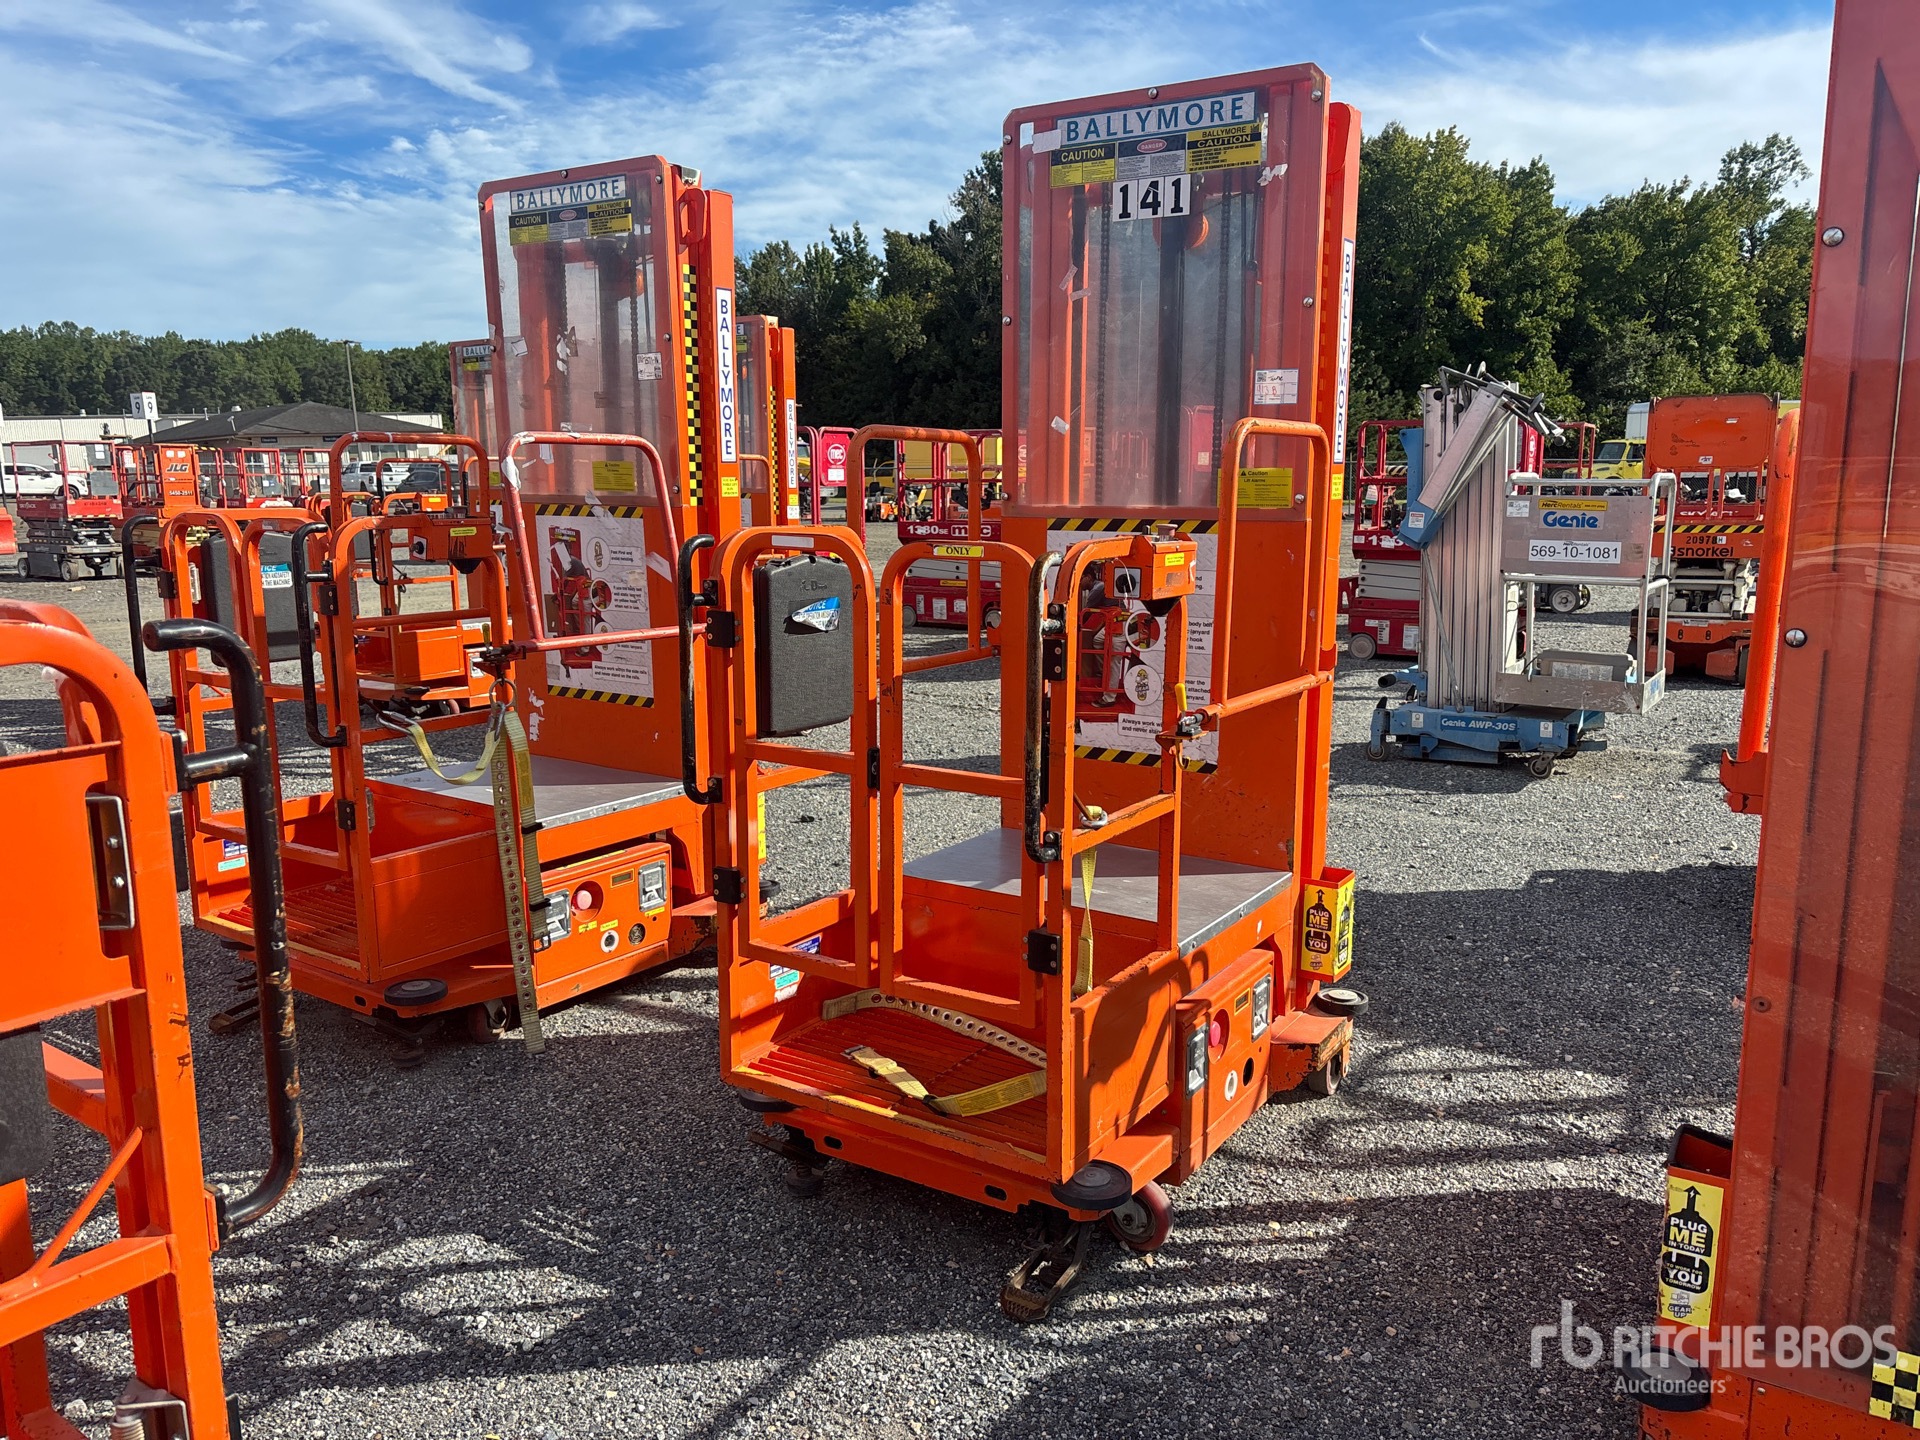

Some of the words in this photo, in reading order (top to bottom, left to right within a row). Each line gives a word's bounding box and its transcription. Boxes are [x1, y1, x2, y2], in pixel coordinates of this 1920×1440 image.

[1066, 96, 1244, 142] BALLYMORE
[1202, 126, 1247, 138] BALLYMORE
[1141, 142, 1164, 150] DANGER
[1197, 134, 1251, 148] CAUTION
[1061, 147, 1105, 162] CAUTION
[516, 179, 619, 210] BALLYMORE
[1118, 177, 1184, 219] 141
[594, 208, 625, 218] CAUTION
[515, 215, 541, 226] CAUTION
[1336, 253, 1350, 454] BALLYMORE
[720, 299, 733, 454] BALLYMORE
[135, 402, 140, 414] 9
[148, 402, 153, 414] 9
[788, 404, 796, 485] BALLYMORE
[167, 464, 189, 473] JLG
[1543, 511, 1599, 528] Genie
[951, 525, 992, 537] mc
[946, 547, 971, 556] ONLY
[1531, 545, 1618, 559] 569-10-1081
[1677, 546, 1734, 557] snorkel
[1122, 718, 1141, 726] Always
[1441, 718, 1466, 727] Genie
[1468, 720, 1516, 731] AWP-30S
[1309, 908, 1329, 918] PLUG
[1309, 915, 1329, 927] ME
[1308, 939, 1328, 950] YOU
[1670, 1216, 1708, 1234] PLUG
[1669, 1226, 1707, 1249] ME
[1668, 1240, 1677, 1248] IN
[1679, 1243, 1706, 1255] TODAY
[1675, 1265, 1690, 1273] WORK
[1668, 1268, 1703, 1286] YOU
[1665, 1277, 1702, 1291] TOMORROW
[1668, 1305, 1692, 1314] GEAR
[1675, 1311, 1686, 1319] UP
